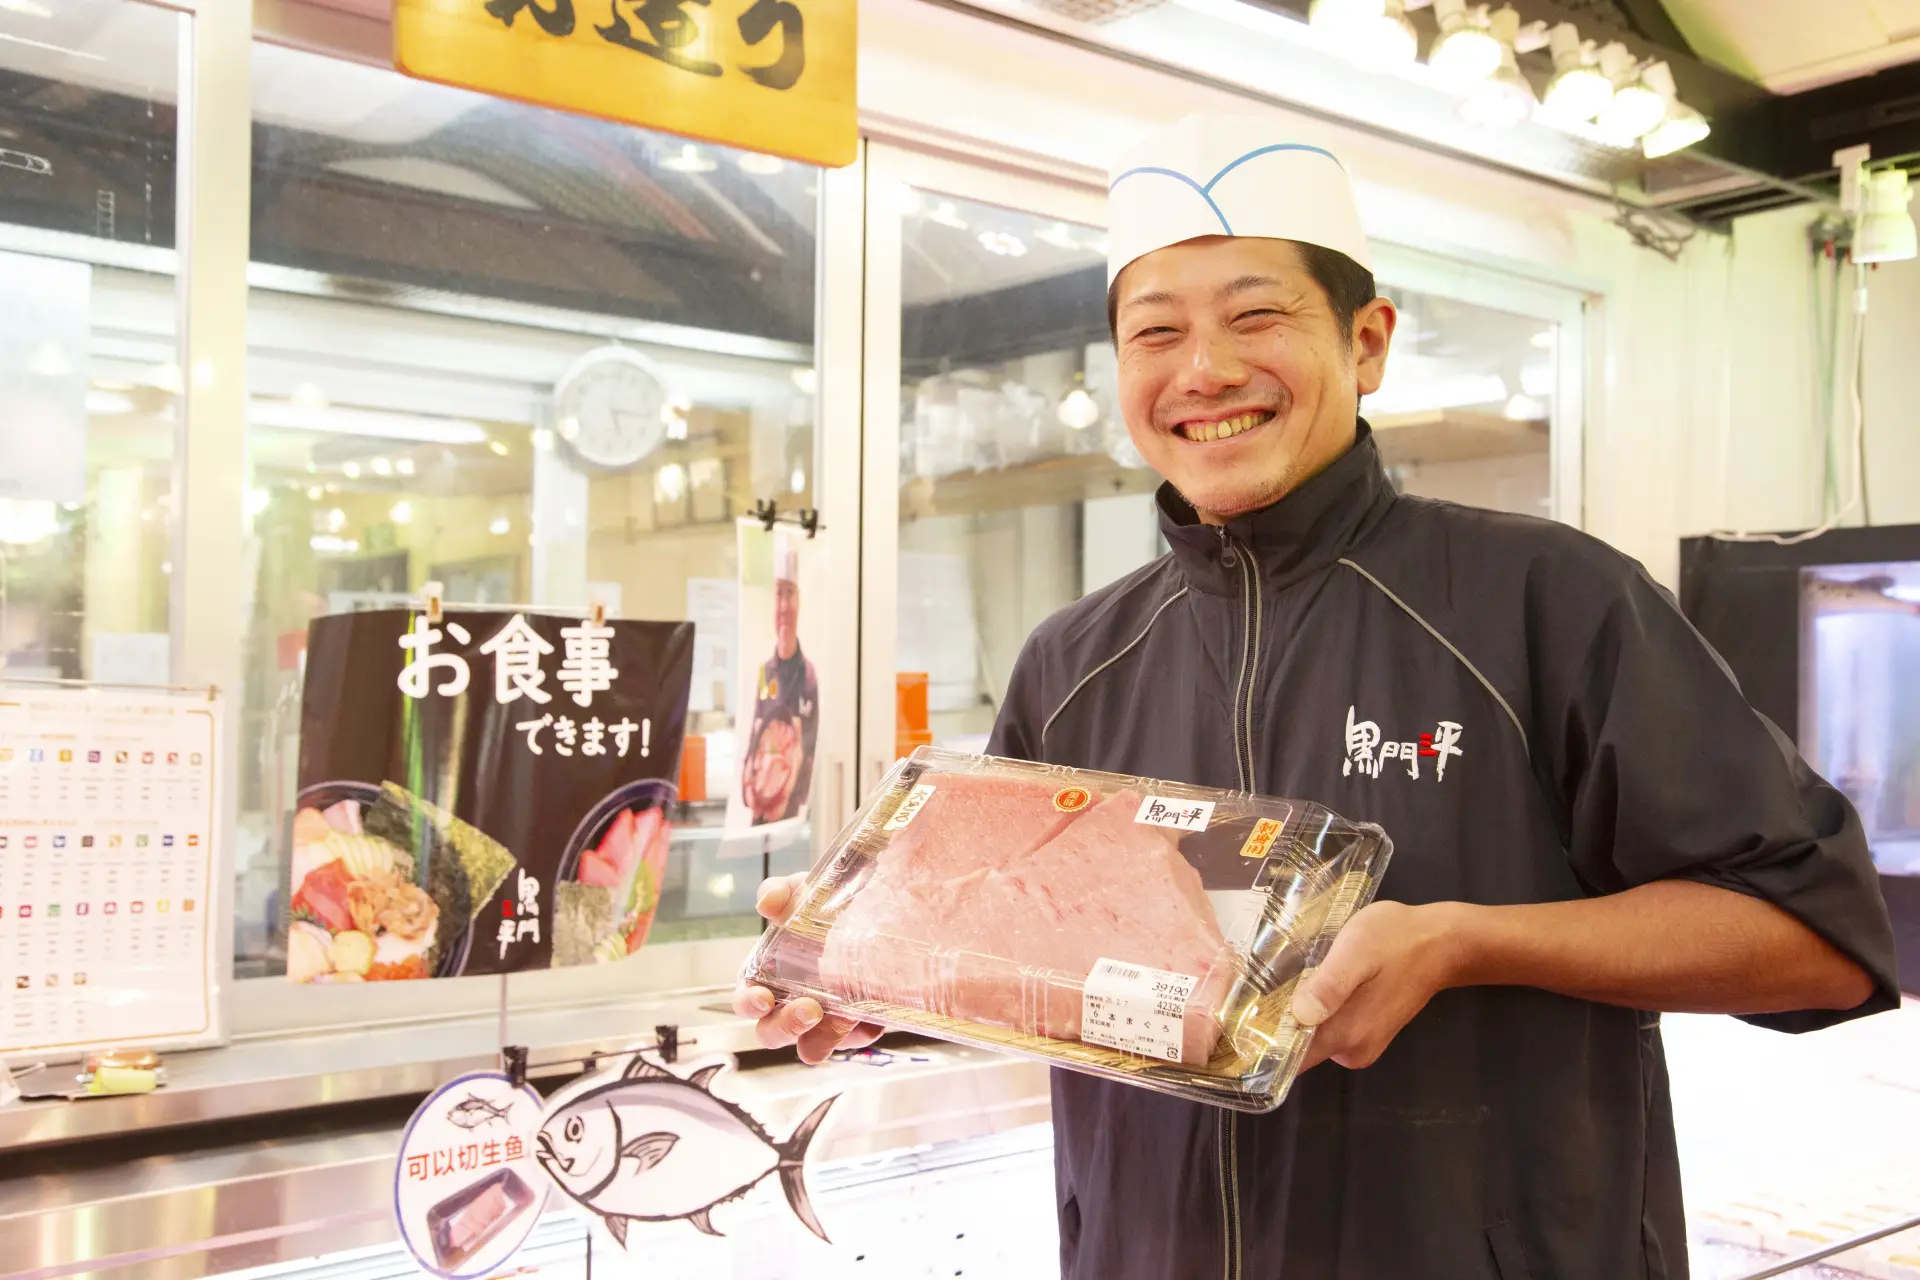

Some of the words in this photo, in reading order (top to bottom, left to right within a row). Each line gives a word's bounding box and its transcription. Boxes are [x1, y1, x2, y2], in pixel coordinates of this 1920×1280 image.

[397, 613, 618, 707] お食事
[1342, 705, 1464, 782] 黒門三平
[1145, 799, 1204, 826] 黒門三平
[1246, 821, 1277, 854] 刺身用
[1152, 982, 1189, 997] 39190
[1157, 1001, 1182, 1013] 42326
[407, 1135, 525, 1181] 可以切生鱼
